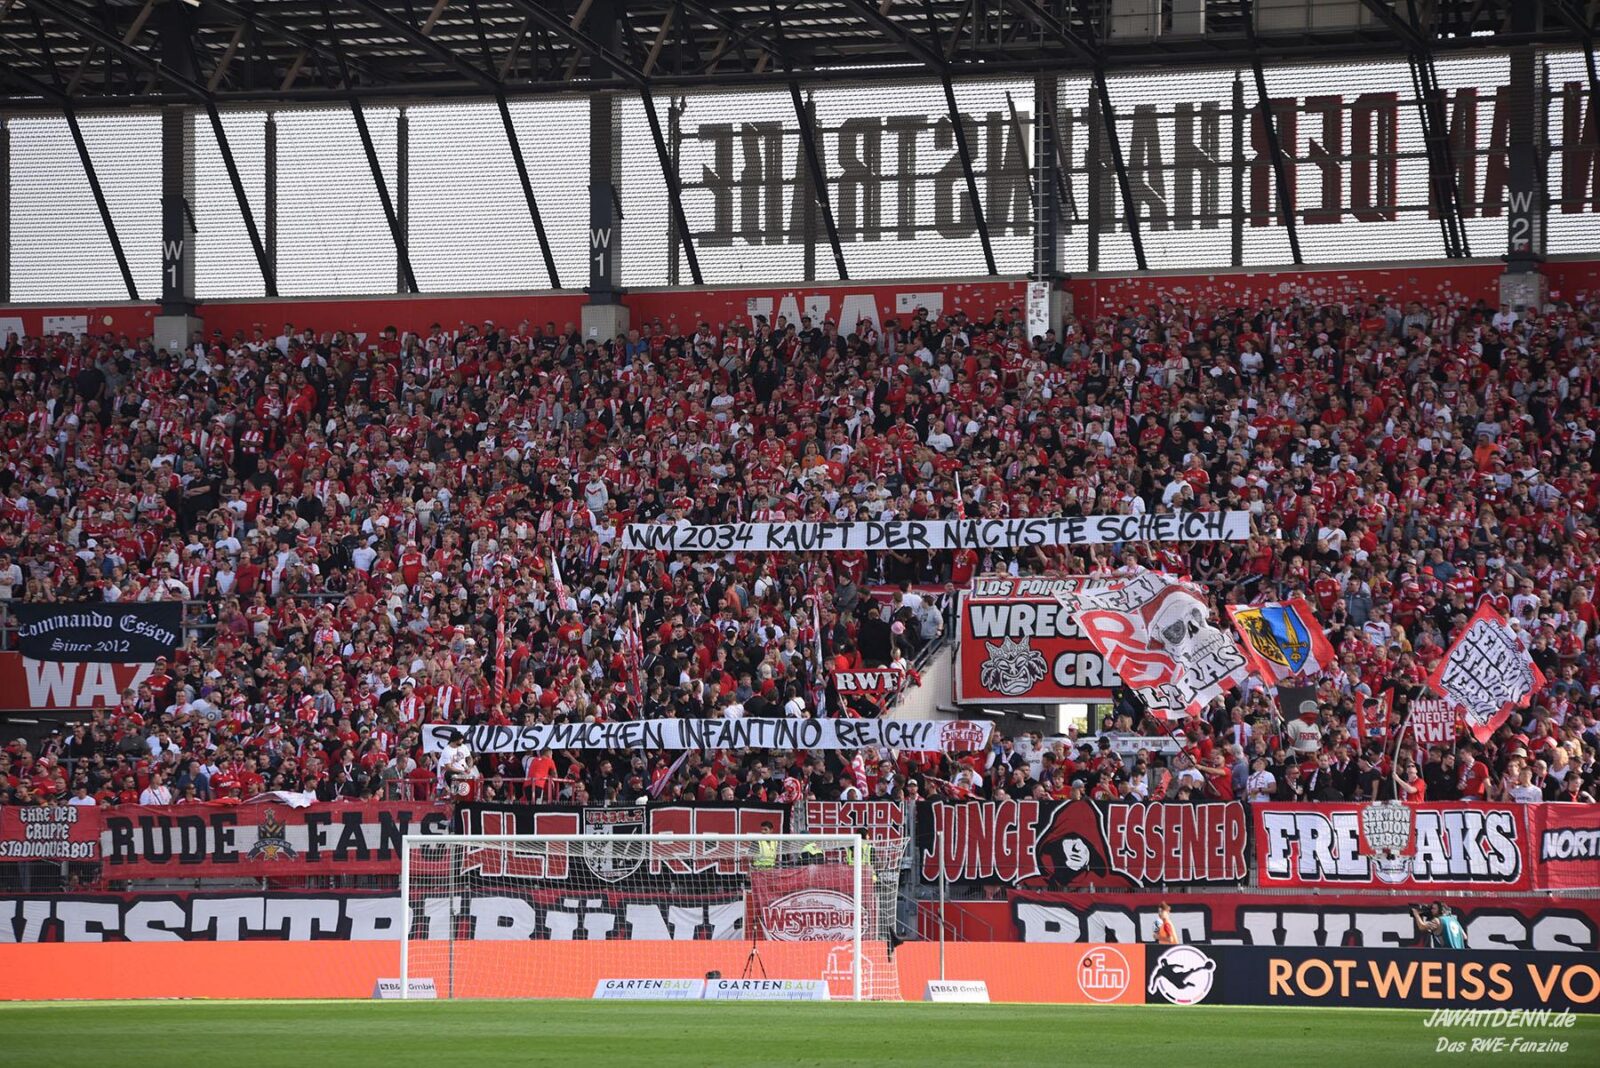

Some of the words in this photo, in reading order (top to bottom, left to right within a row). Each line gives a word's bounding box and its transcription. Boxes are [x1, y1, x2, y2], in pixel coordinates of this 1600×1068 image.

[1508, 191, 1533, 213] W
[590, 227, 612, 249] W
[1511, 217, 1530, 243] 2
[163, 240, 183, 260] W
[167, 264, 177, 288] 1
[594, 252, 604, 277] 1
[679, 524, 753, 550] 2034
[767, 522, 854, 550] KAUFT
[866, 521, 931, 549] DER
[944, 516, 1088, 548] NÄCHSTE
[977, 580, 1012, 596] LOS
[18, 611, 113, 638] Commando
[119, 613, 176, 646] Essen
[971, 604, 1088, 637] WREC
[51, 637, 92, 652] Since
[94, 640, 130, 652] 2012
[1137, 645, 1247, 711] LTRAS
[1412, 711, 1454, 723] WIEDER
[544, 722, 664, 750] MACHEN
[678, 717, 822, 749] INFANTINO
[835, 718, 933, 749] REICH!
[1413, 722, 1456, 742] RWE
[20, 807, 51, 822] EHRE
[54, 806, 77, 822] DER
[806, 800, 905, 827] SEKTION
[1362, 808, 1411, 822] SEKTION
[107, 813, 239, 865] RUDE
[304, 811, 448, 862] FANS
[1363, 821, 1410, 835] STADION
[922, 801, 1040, 883] JUNGE
[1107, 801, 1247, 883] ESSENER
[1083, 953, 1125, 989] ifm
[1268, 957, 1514, 1002] ROT-WEISS
[606, 979, 692, 990] GARTENBAU
[718, 980, 816, 991] GARTENBAU
